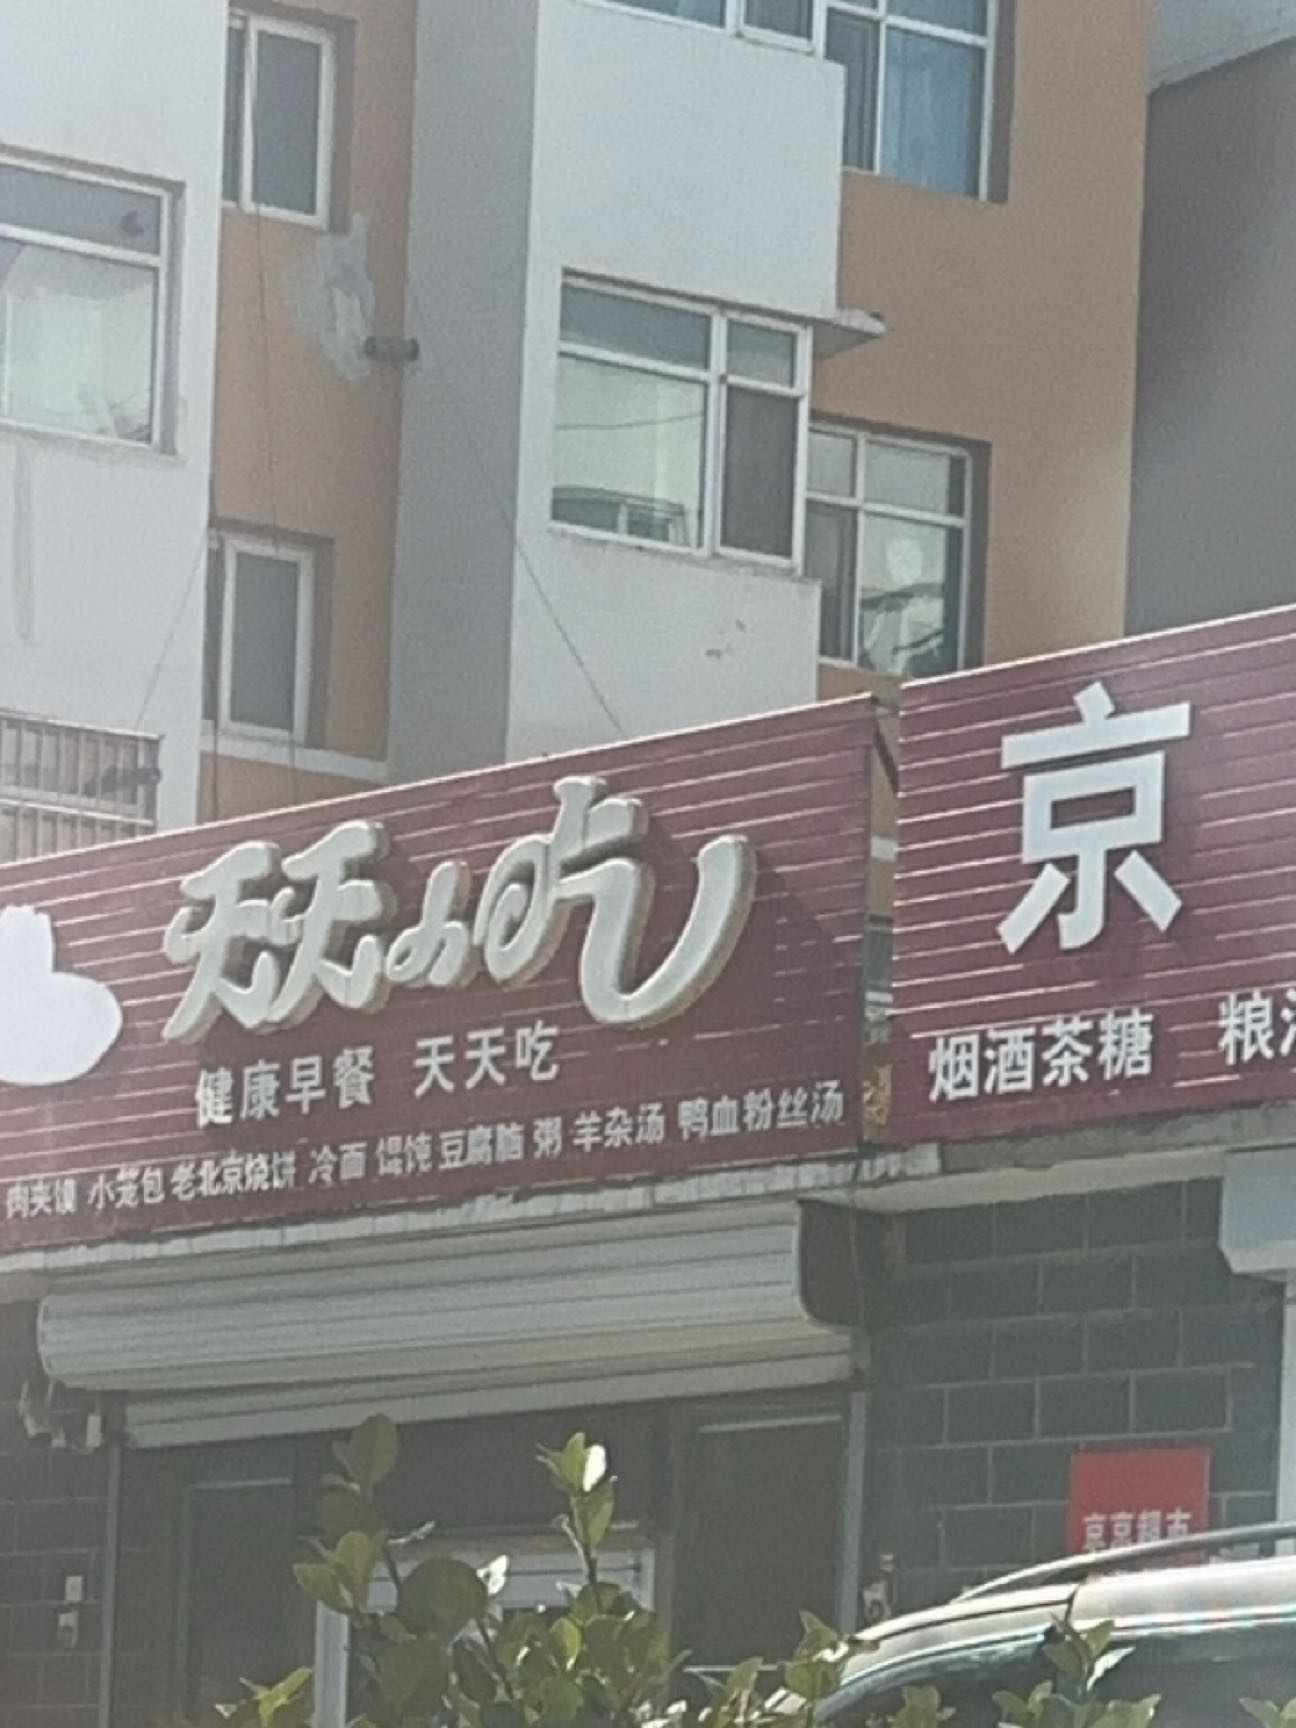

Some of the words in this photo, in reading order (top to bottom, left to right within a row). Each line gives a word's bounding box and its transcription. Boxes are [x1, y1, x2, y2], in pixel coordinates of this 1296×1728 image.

[998, 682, 1192, 954] 京
[162, 775, 757, 1043] 天天小吃
[196, 1046, 376, 1127] 健康早餐
[414, 1020, 560, 1097] 天天吃
[929, 1007, 1153, 1103] 烟酒茶糖
[6, 1178, 78, 1219] 肉夹馍
[88, 1165, 165, 1210] 小笼包
[171, 1151, 296, 1200] 老北京烧饼
[308, 1142, 368, 1187] 冷面
[376, 1132, 433, 1176] 馄饨
[438, 1122, 525, 1171] 豆腐脑
[534, 1116, 563, 1159] 粥
[573, 1101, 665, 1152] 羊杂汤
[677, 1079, 844, 1141] 鸭血粉丝汤
